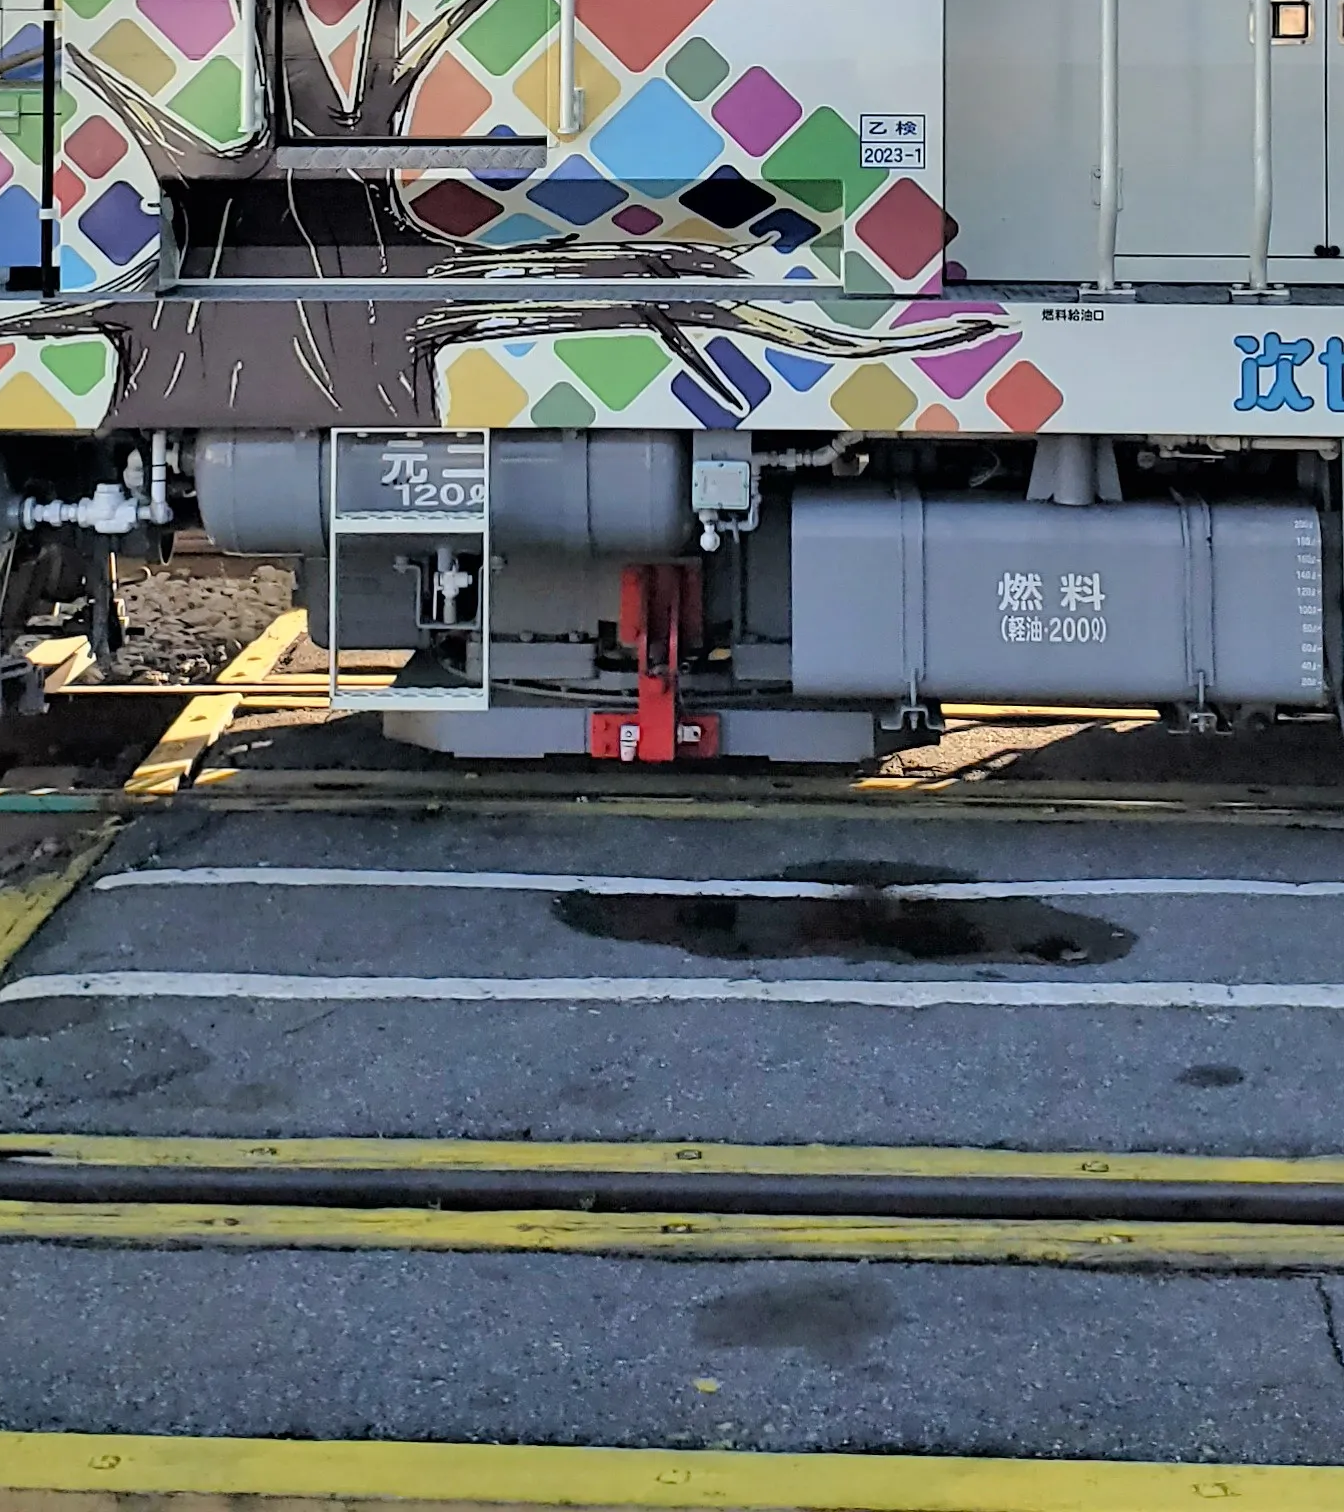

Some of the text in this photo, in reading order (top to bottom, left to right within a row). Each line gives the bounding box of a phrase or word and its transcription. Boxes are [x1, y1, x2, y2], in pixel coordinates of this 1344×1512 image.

[864, 147, 922, 164] 2023-1
[1041, 308, 1105, 322] 燃料給油口
[998, 572, 1105, 611] 燃料
